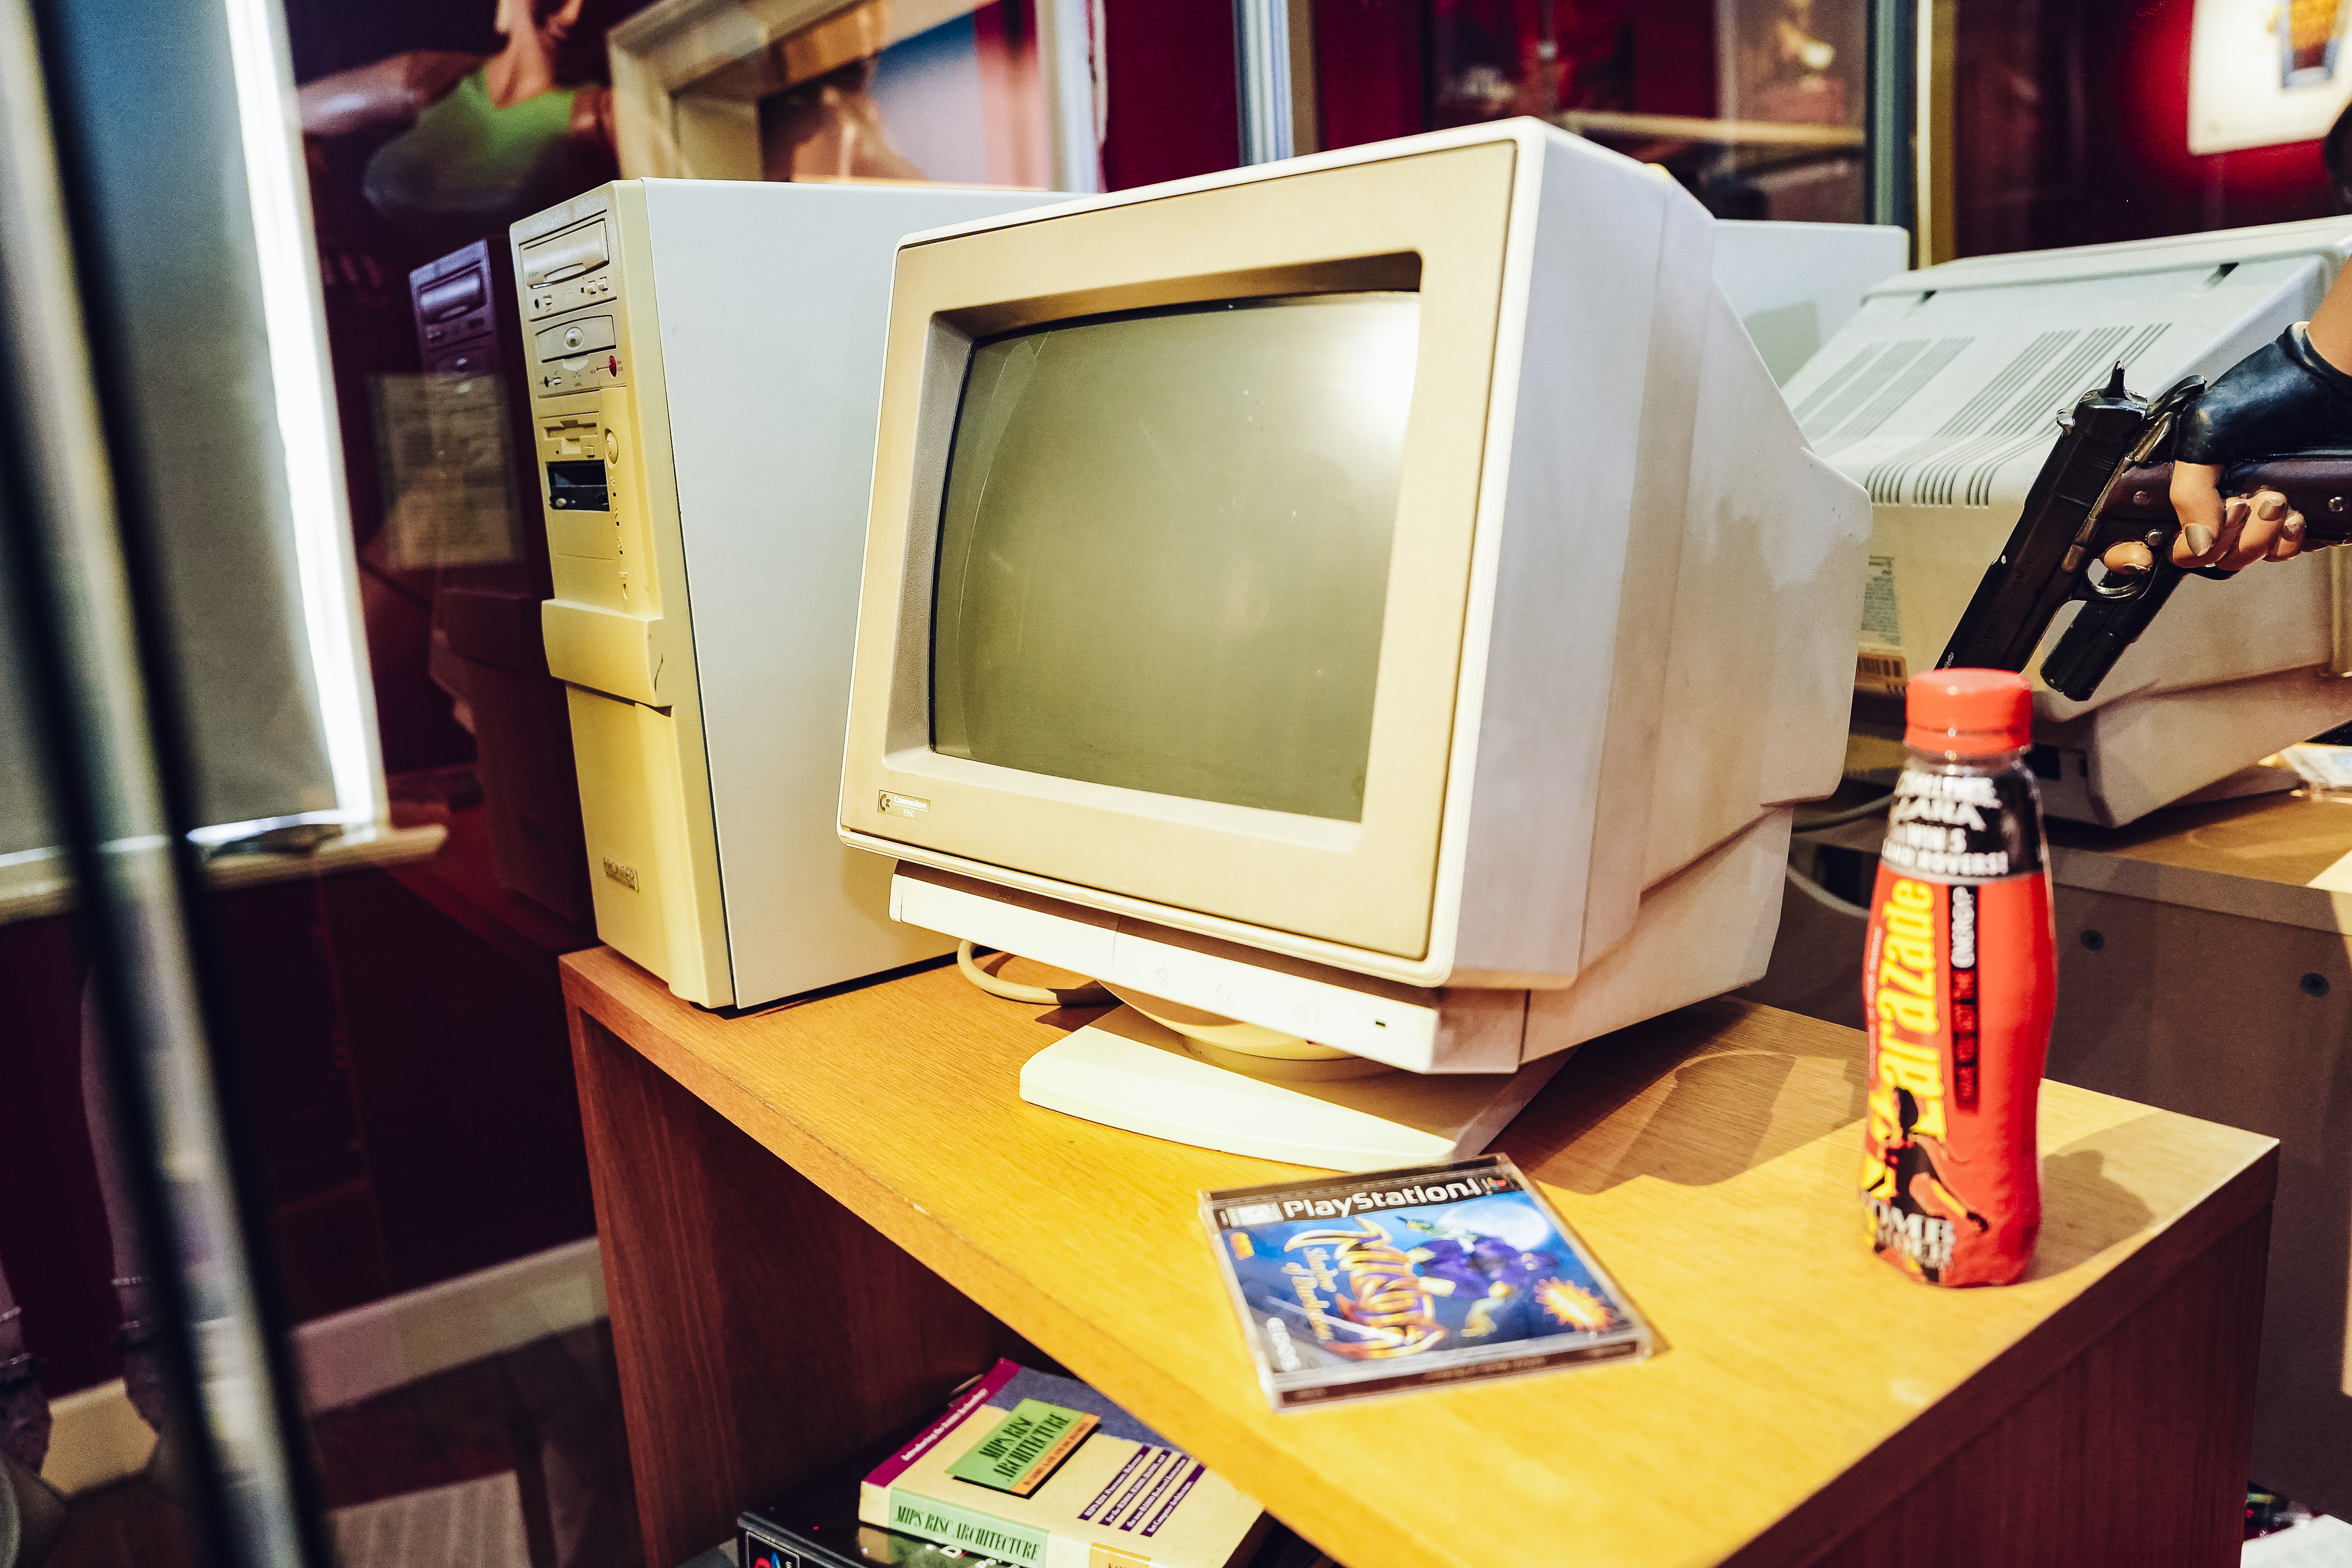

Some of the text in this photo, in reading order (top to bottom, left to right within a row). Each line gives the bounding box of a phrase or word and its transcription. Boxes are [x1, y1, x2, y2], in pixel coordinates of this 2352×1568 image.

[894, 795, 927, 810] Commodore
[903, 808, 915, 818] 1960
[1868, 879, 1947, 1142] Larazade
[1283, 1183, 1471, 1218] PlayStation
[978, 1435, 1015, 1460] MIPS
[895, 1505, 924, 1527] MIPS
[925, 1513, 953, 1534] RISC
[951, 1522, 1040, 1560] ARCHITECTURE
